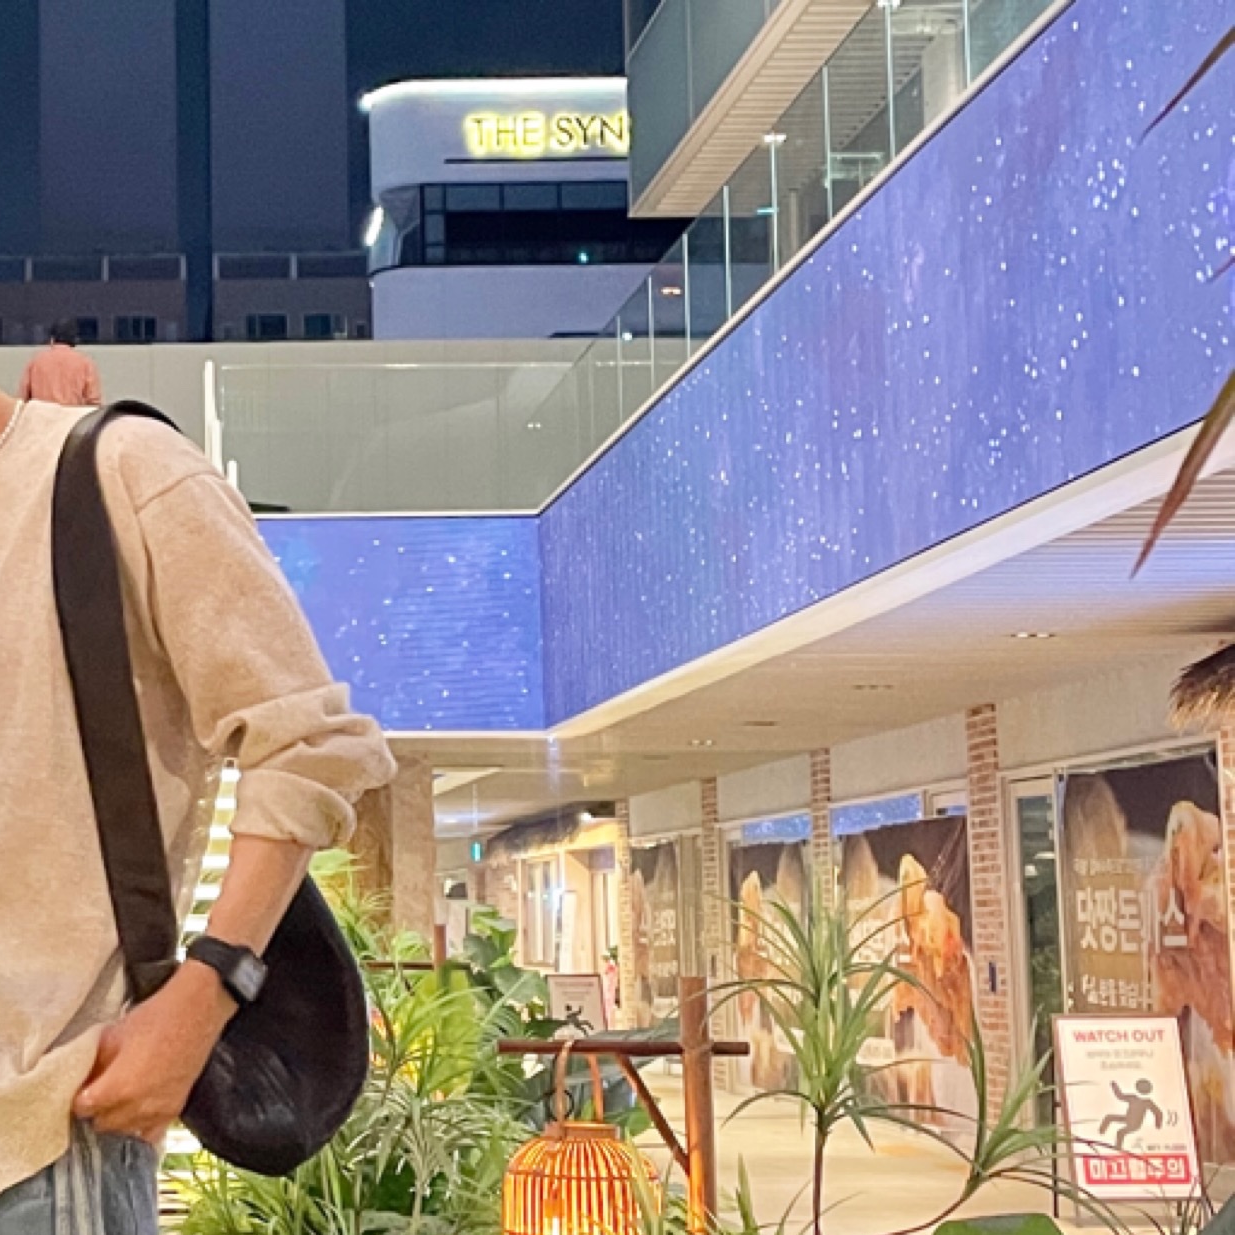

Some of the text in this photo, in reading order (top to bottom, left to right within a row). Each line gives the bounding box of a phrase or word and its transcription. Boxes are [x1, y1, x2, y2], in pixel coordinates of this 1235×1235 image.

[469, 115, 541, 147] THE
[1072, 1029, 1166, 1043] WATCH OUT
